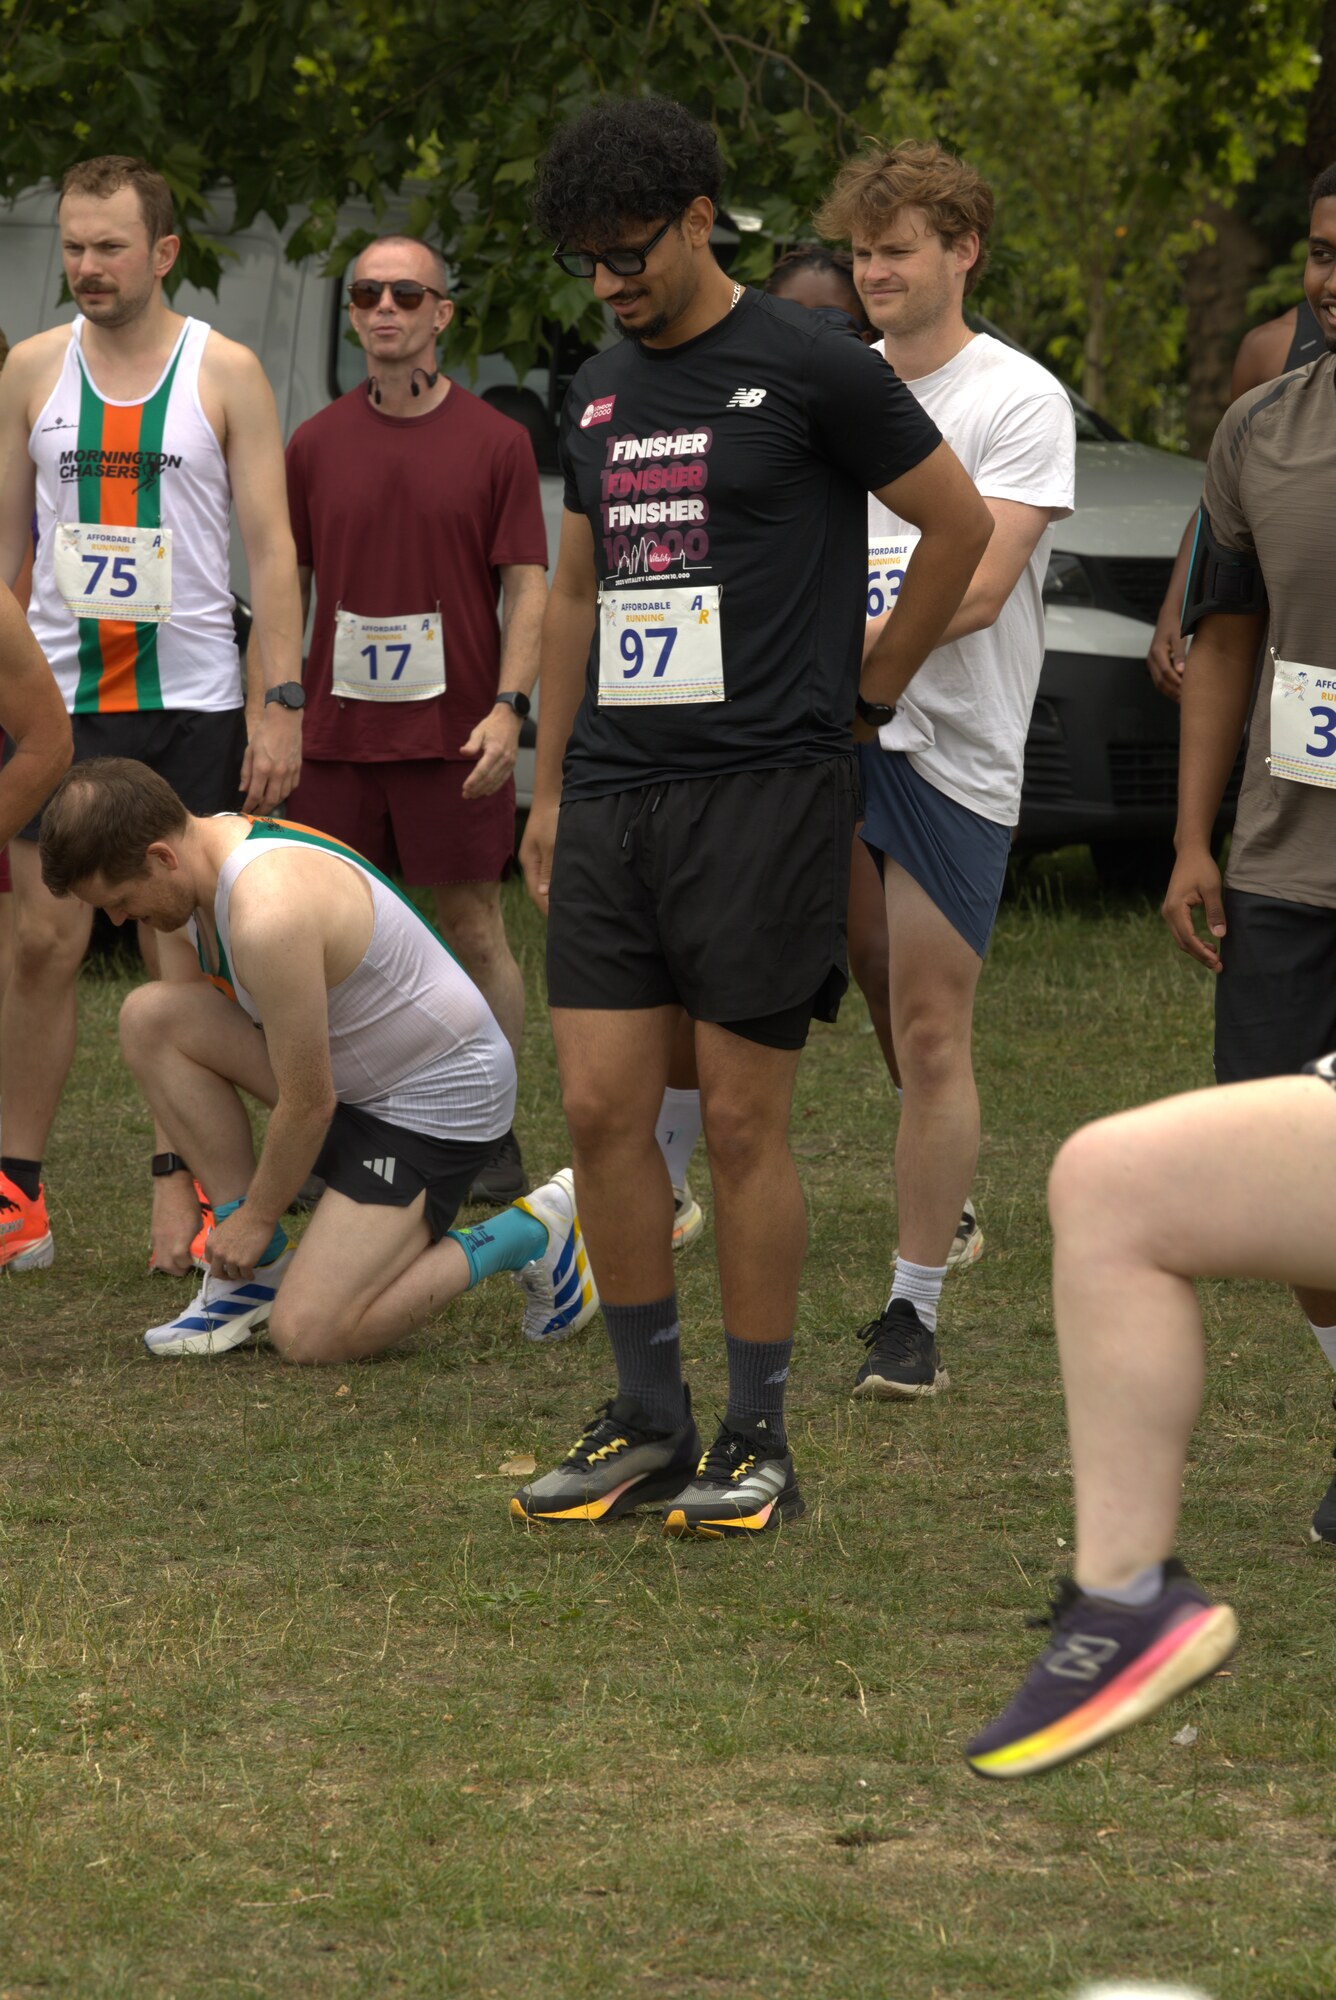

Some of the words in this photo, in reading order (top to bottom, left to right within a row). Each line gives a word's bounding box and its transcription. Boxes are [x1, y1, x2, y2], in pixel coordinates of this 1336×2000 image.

[612, 433, 708, 462] FINISHER
[60, 450, 183, 469] MORNINGTON
[60, 464, 141, 479] CHASERS
[607, 465, 703, 494] FINISHER
[609, 499, 705, 528] FINISHER
[87, 533, 137, 545] AFFORDABLE
[91, 543, 130, 553] RUNNING
[868, 546, 908, 556] FFORDABLE
[649, 552, 671, 564] Vitality
[82, 554, 138, 598] 75
[645, 574, 670, 582] LONDON
[670, 572, 691, 580] 10,000
[866, 569, 906, 617] 63
[621, 600, 671, 611] AFFORDABLE
[626, 613, 665, 622] RUNNING
[361, 624, 407, 632] AFFORDABLE
[619, 627, 678, 679] 97
[360, 643, 412, 681] 17
[1306, 706, 1336, 758] 3
